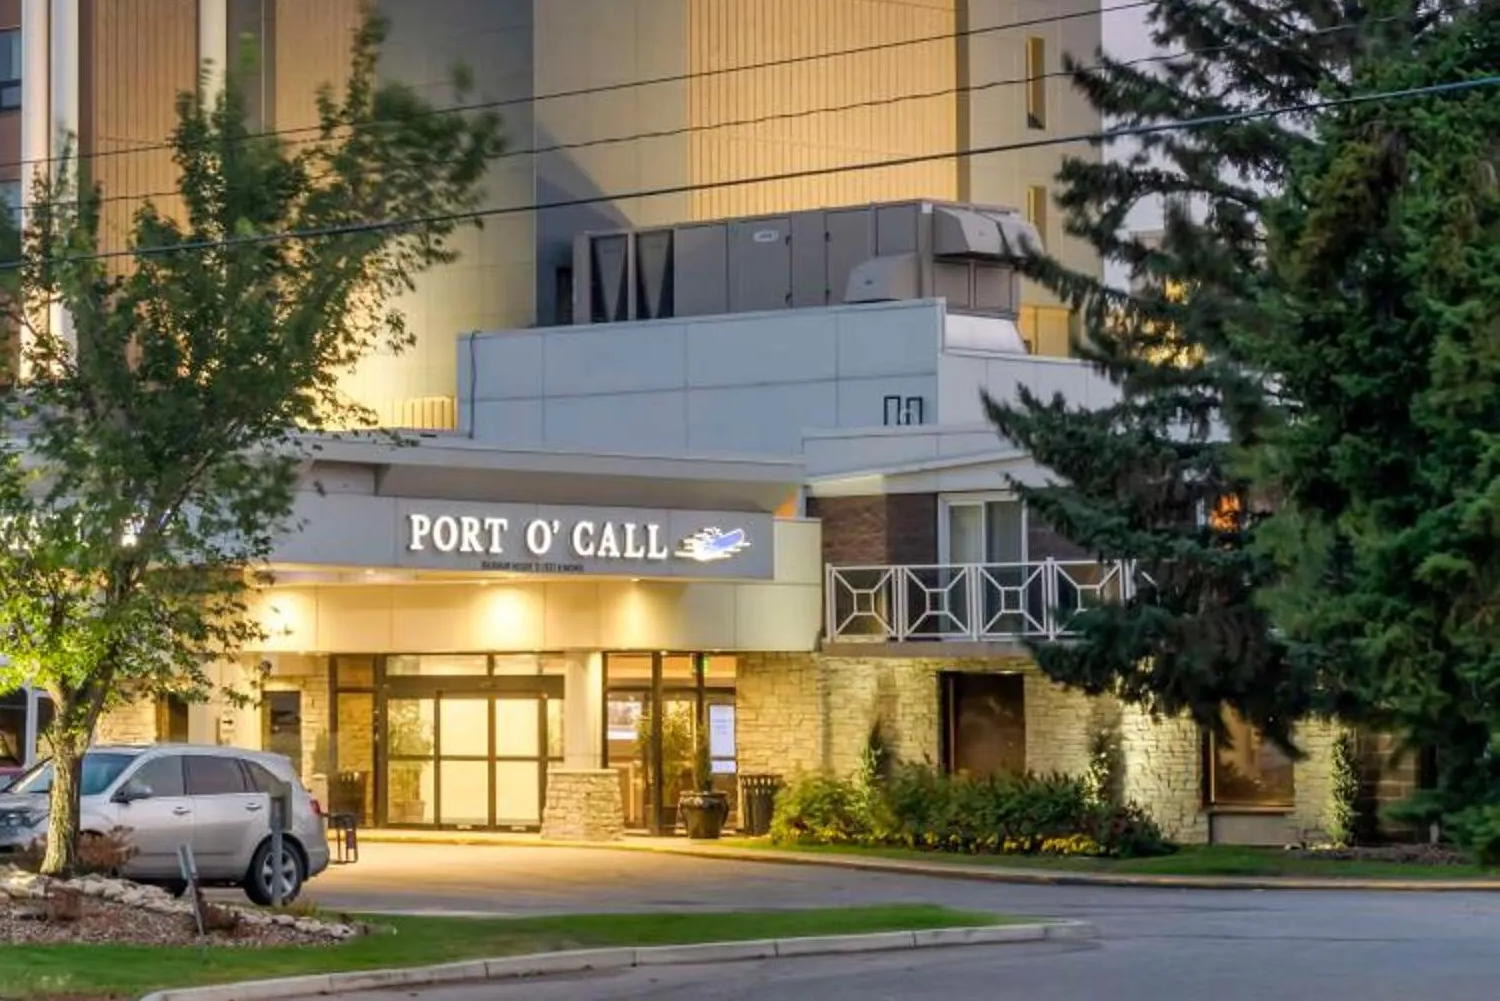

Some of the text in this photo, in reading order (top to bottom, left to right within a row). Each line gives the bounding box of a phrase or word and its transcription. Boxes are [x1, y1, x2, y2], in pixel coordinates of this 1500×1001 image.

[409, 513, 668, 560] PORT O' CALL
